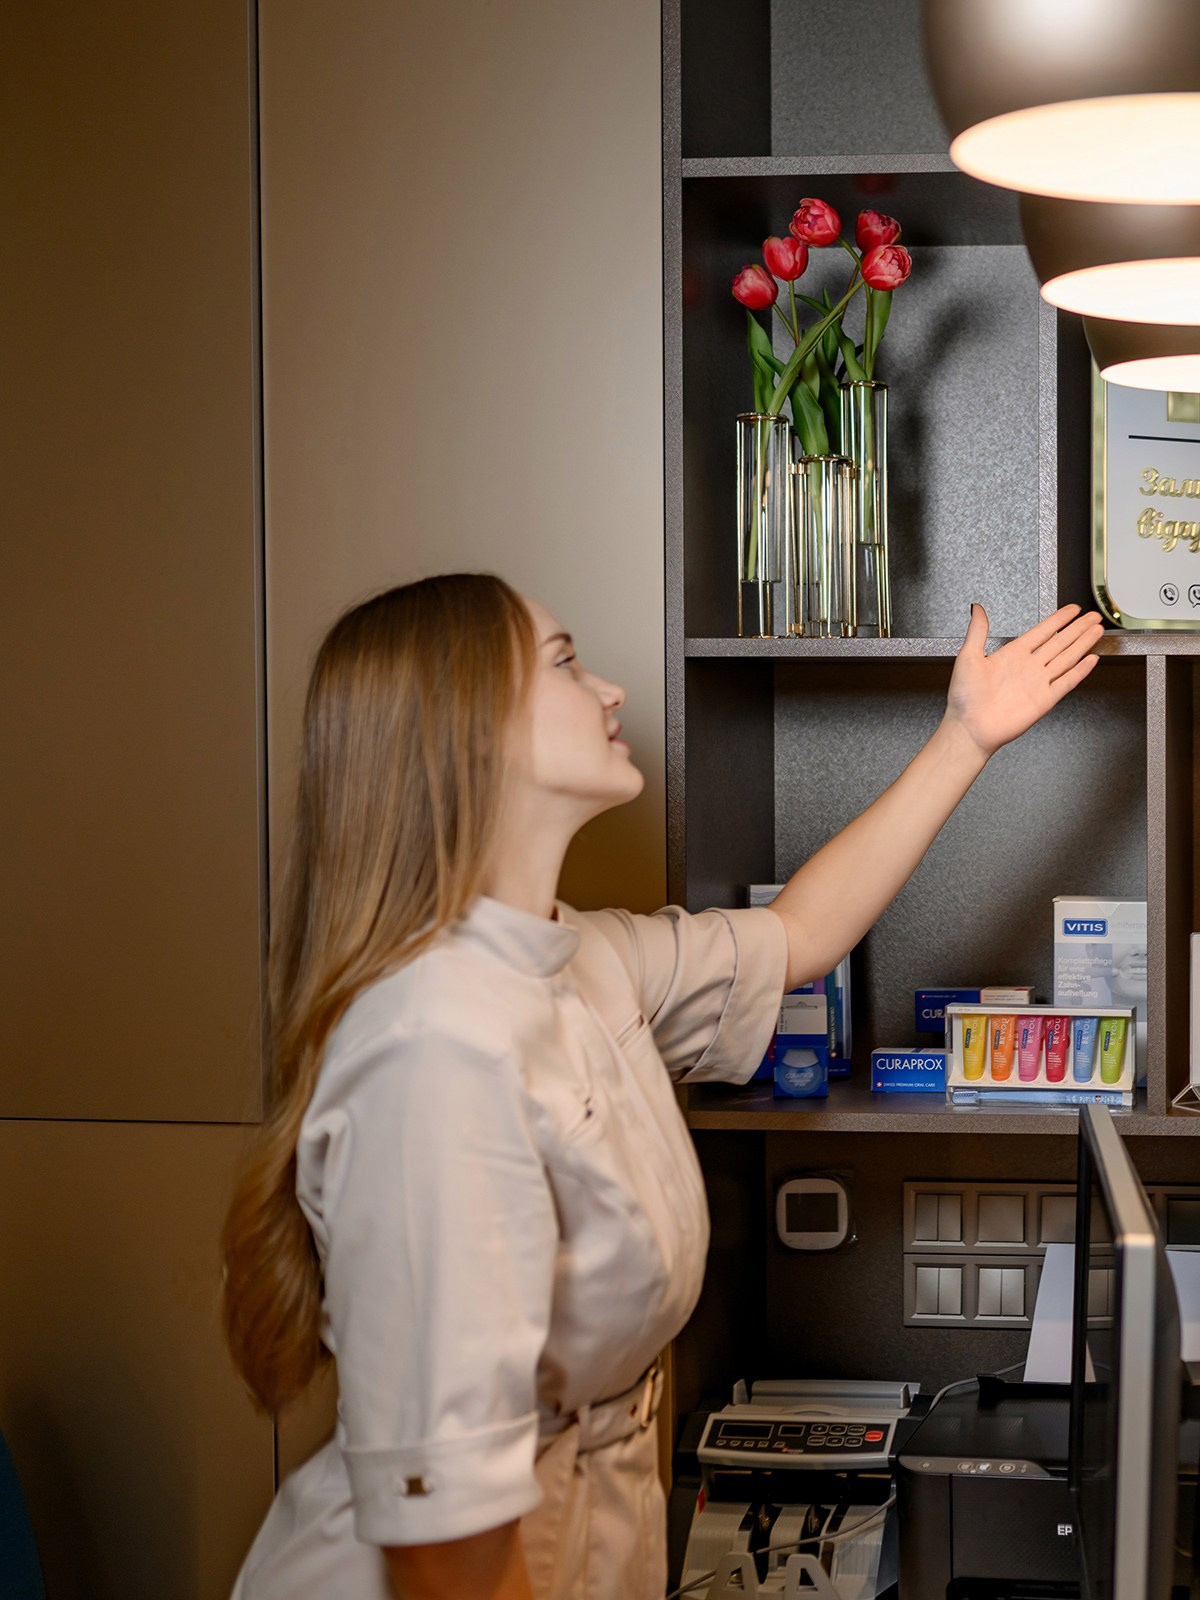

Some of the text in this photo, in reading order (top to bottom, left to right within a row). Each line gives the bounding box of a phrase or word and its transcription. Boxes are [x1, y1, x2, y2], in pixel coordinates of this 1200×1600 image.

[1066, 923, 1104, 932] VITIS
[1057, 973, 1091, 981] effektive
[1057, 989, 1098, 998] aufhellung
[876, 1058, 943, 1071] CURAPROX
